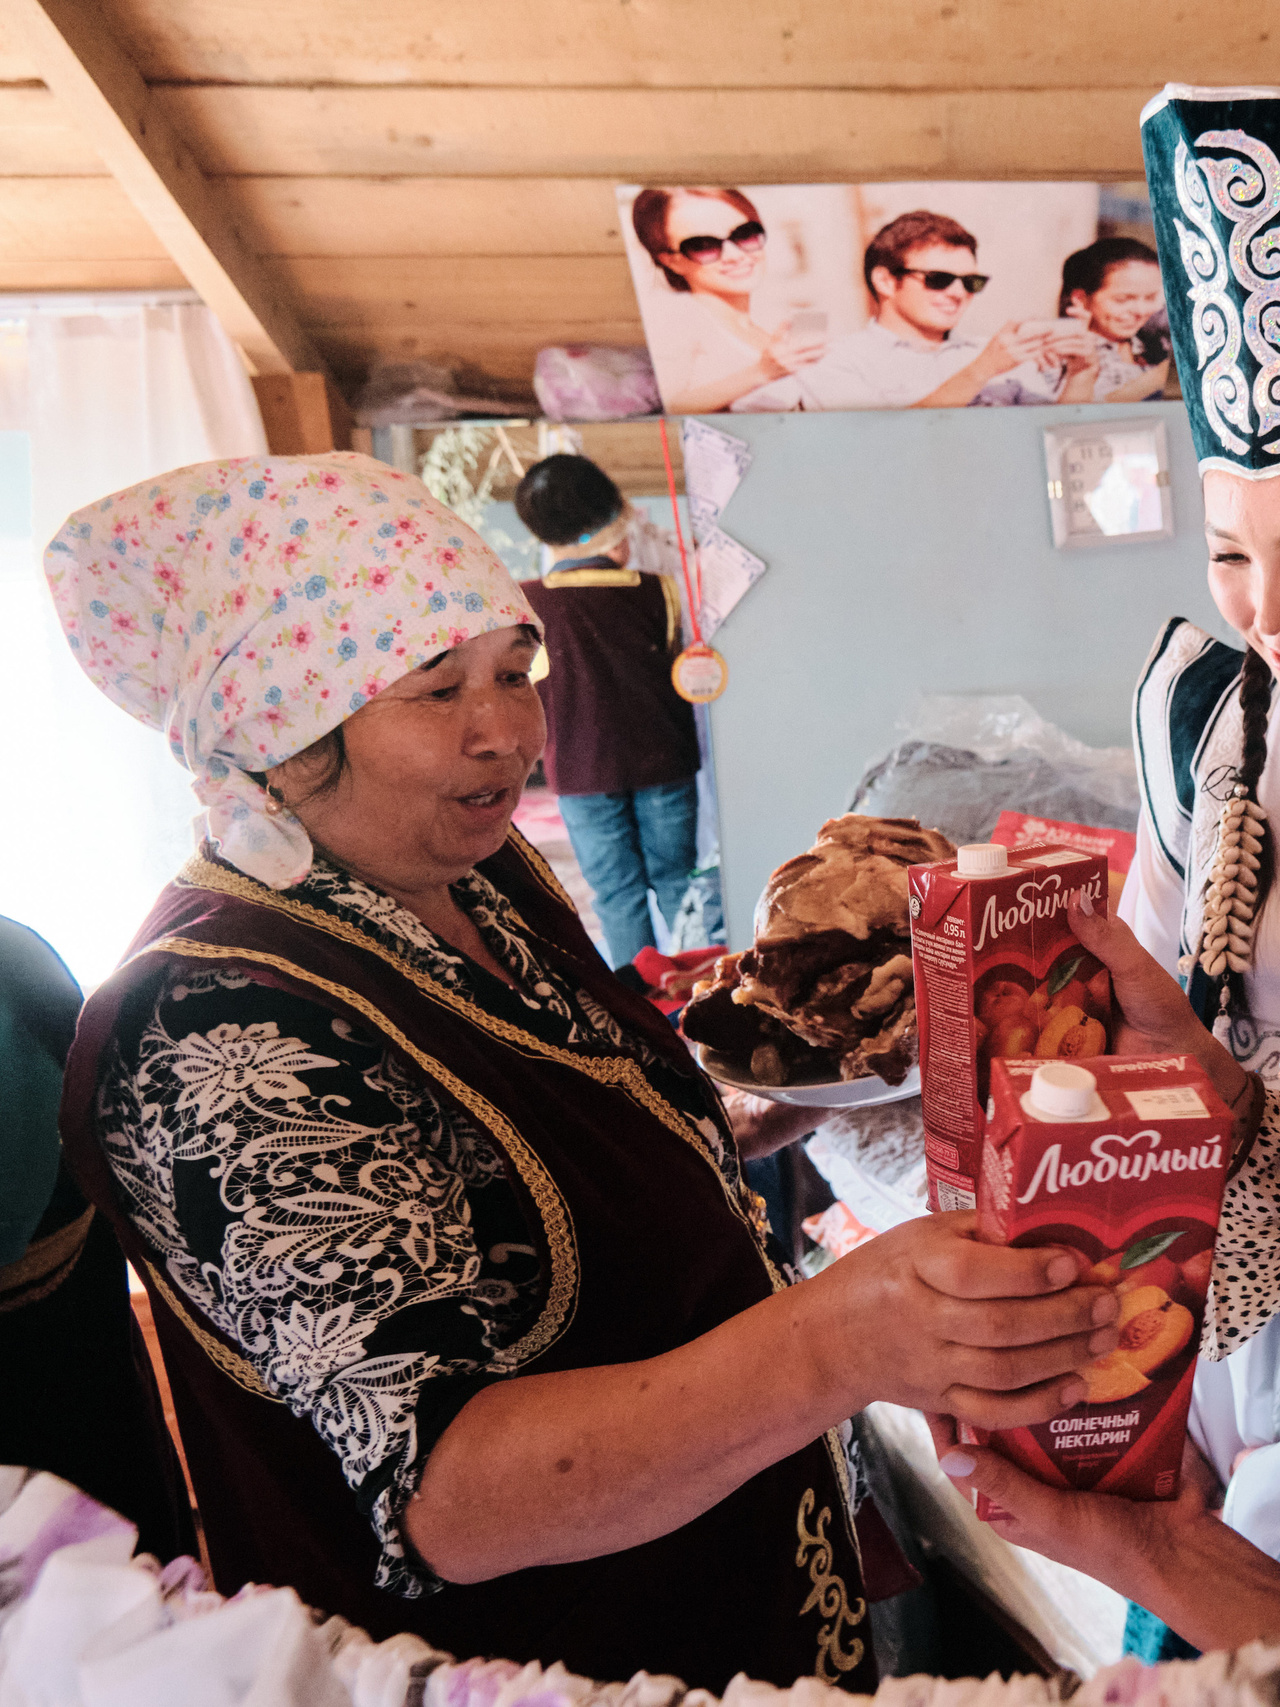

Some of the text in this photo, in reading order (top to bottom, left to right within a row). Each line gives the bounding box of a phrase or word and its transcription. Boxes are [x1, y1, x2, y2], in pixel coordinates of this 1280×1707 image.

[973, 871, 1102, 952] Любимй
[943, 922, 959, 937] 0,95
[1016, 1129, 1223, 1205] Любимый
[1049, 1409, 1140, 1433] СОЛНЕЧНЫЙ
[1054, 1429, 1131, 1449] НЕКТАРИН
